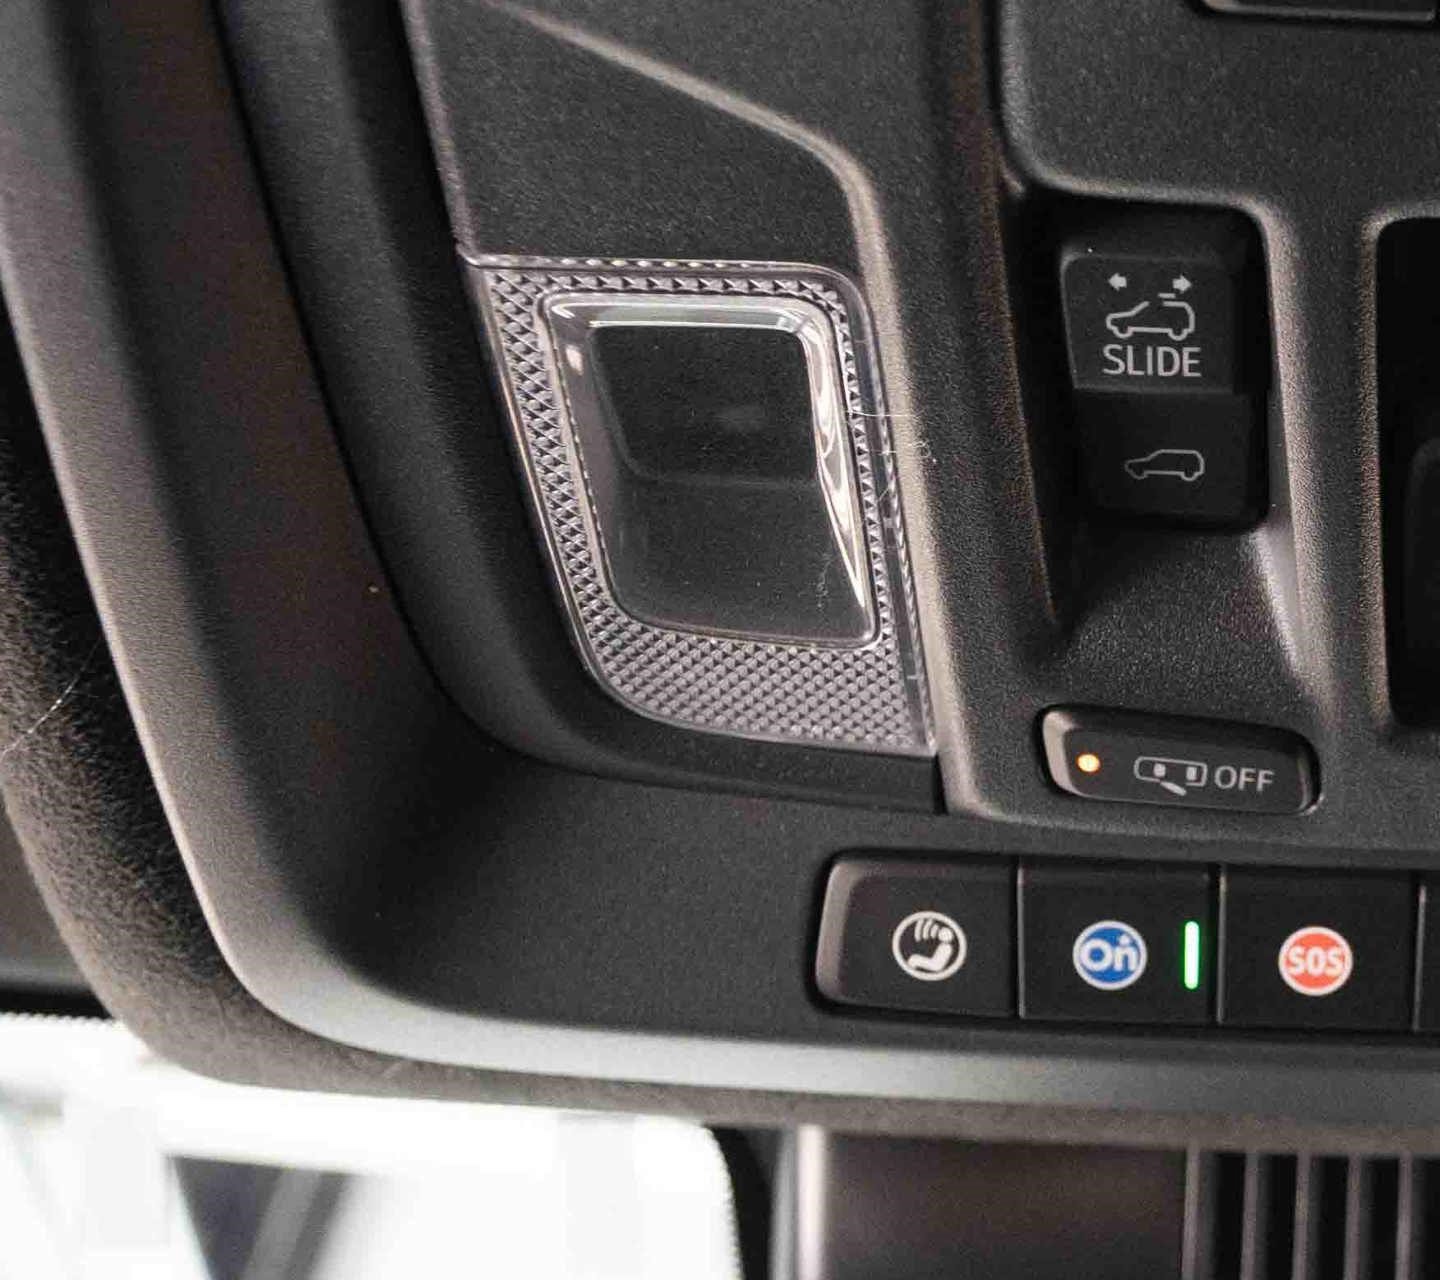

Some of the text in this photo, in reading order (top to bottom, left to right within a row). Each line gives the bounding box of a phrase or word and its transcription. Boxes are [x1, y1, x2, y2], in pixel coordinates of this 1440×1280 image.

[1102, 344, 1203, 379] SLIDE
[1214, 766, 1274, 792] OFF
[1287, 942, 1345, 978] SOS
